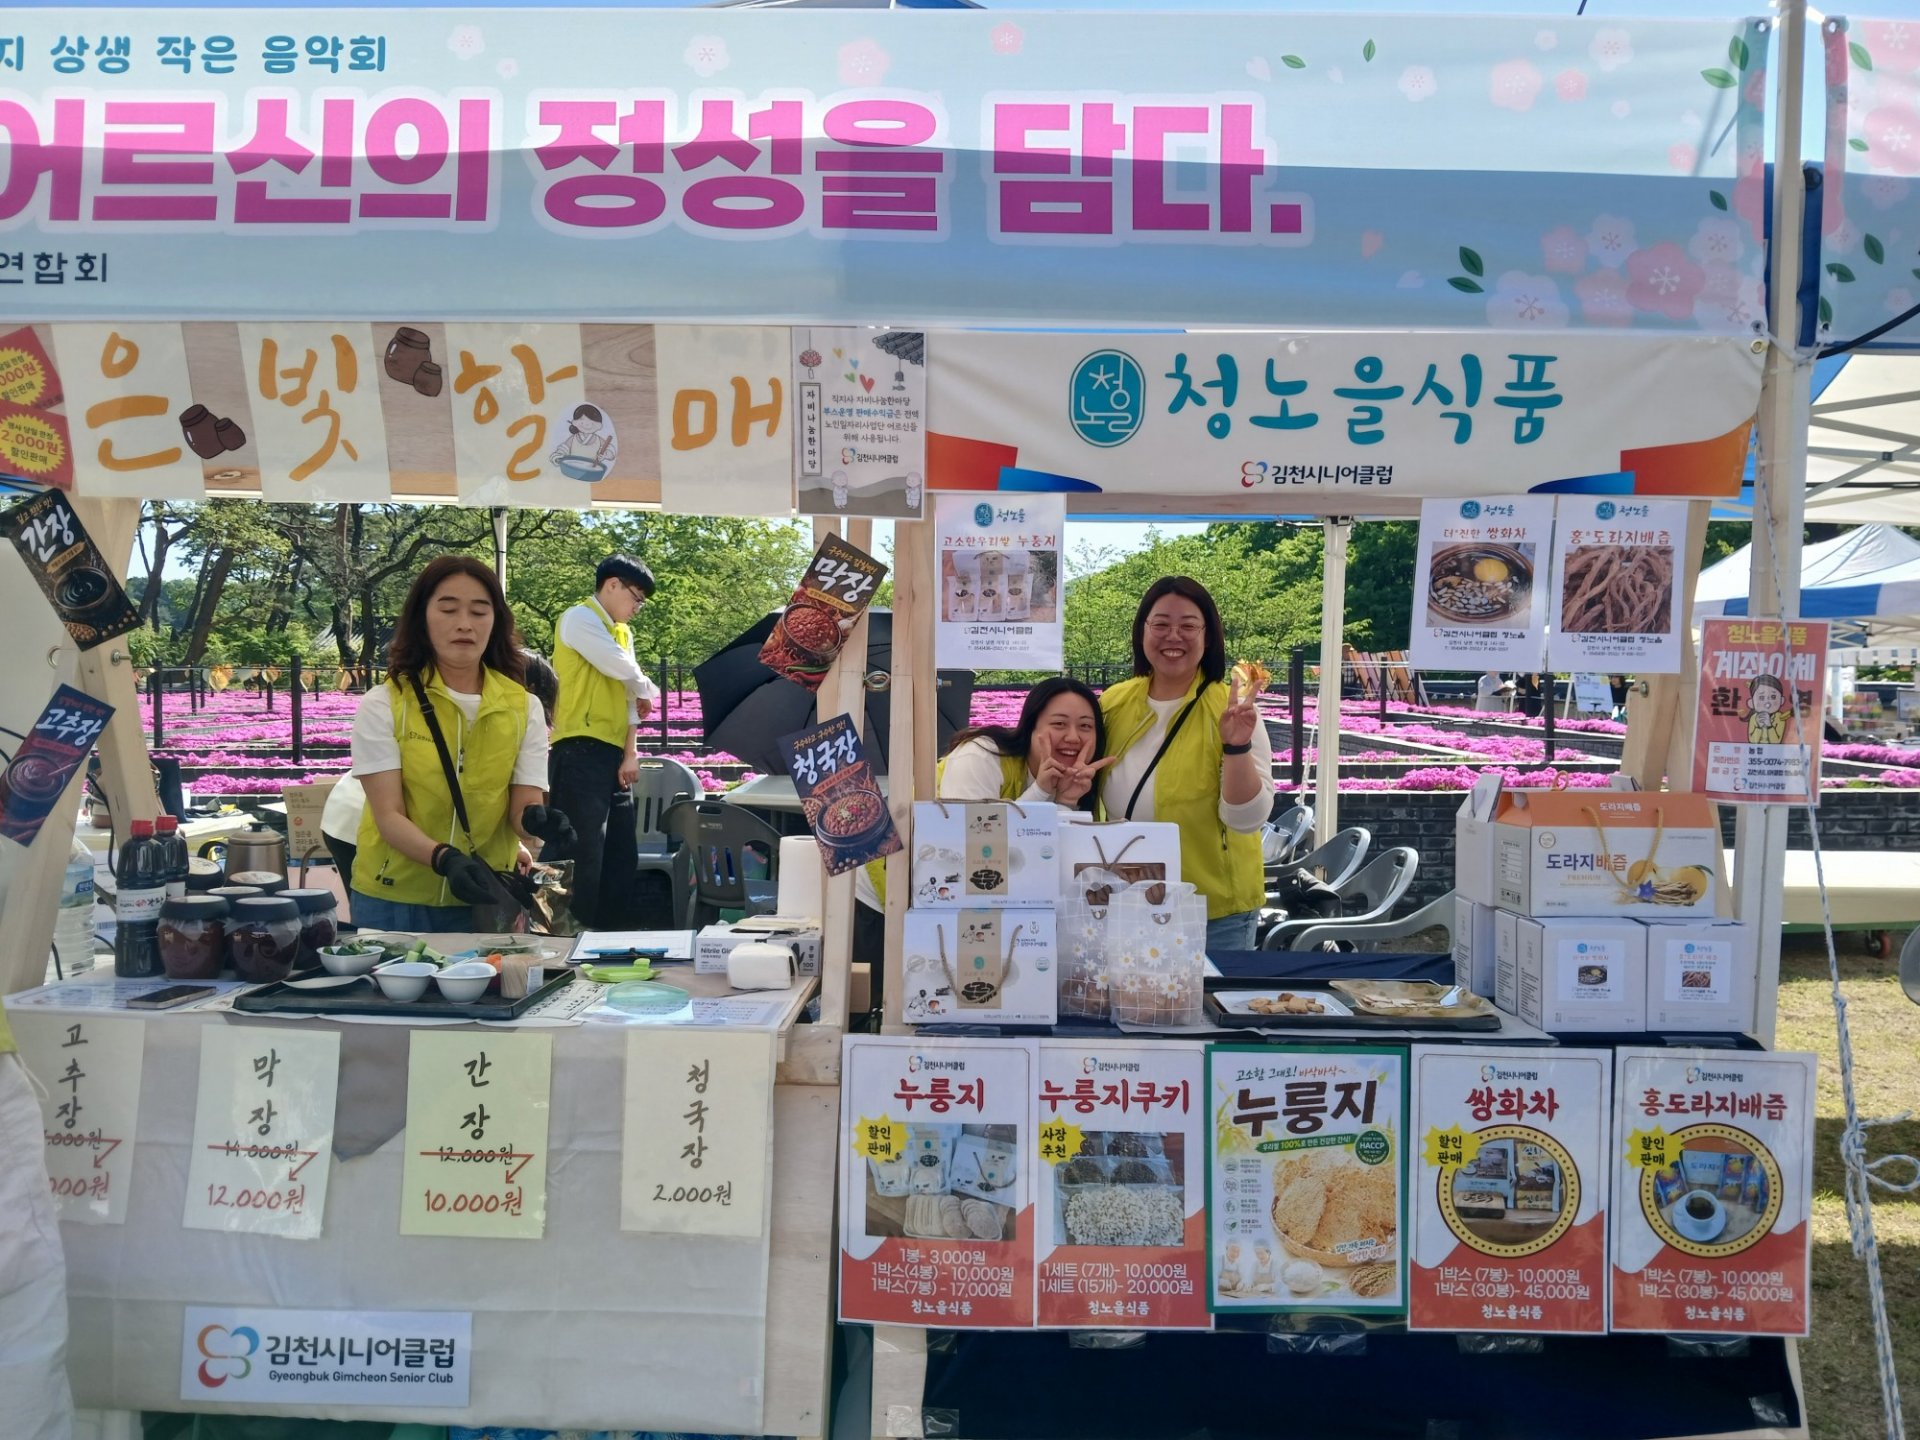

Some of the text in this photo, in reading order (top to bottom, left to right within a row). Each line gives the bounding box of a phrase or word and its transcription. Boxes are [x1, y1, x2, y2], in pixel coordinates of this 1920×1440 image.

[50, 35, 132, 73] 상생
[157, 36, 238, 74] 작은
[261, 35, 387, 73] 음악회
[0, 98, 1302, 234] 어르신의 정성을 담다.
[0, 251, 108, 285] 연합회
[1165, 353, 1563, 446] 청노을식품
[857, 453, 899, 464] 김천시니어클럽
[1271, 463, 1393, 487] 김천시니어클럽
[20, 504, 76, 564] 간장
[1486, 527, 1527, 539] 쌍화차
[814, 556, 874, 603] 막장
[1713, 650, 1816, 682] 계좌이체
[35, 708, 103, 747] 고추장
[792, 729, 858, 786] 청국장
[1546, 853, 1628, 872] 도라지배즙
[923, 1060, 966, 1071] 김천시니어클럽
[1098, 1062, 1140, 1073] 김천시니어클럽
[55, 1023, 88, 1129] 고추장
[1496, 1070, 1538, 1081] 김천시니어클럽
[1701, 1072, 1744, 1083] 김천시니어클럽
[248, 1048, 281, 1136] 막장
[459, 1051, 492, 1140] 간장
[893, 1077, 984, 1114] 누룽지
[1039, 1078, 1190, 1115] 누룽지쿠키
[1232, 1080, 1378, 1138] 누룽지
[1464, 1086, 1560, 1123] 쌍화차
[1639, 1088, 1788, 1121] 홍도라지배즙
[680, 1059, 710, 1169] 청국장
[868, 1124, 892, 1140] 할인
[1041, 1127, 1067, 1142] 사장
[1438, 1133, 1463, 1149] 할인
[867, 1141, 892, 1156] 판매
[1041, 1143, 1067, 1158] 추천
[1359, 1141, 1385, 1151] HACCP
[1641, 1135, 1665, 1150] 할인
[1437, 1151, 1463, 1165] 판매
[1640, 1152, 1666, 1166] 판매
[929, 1249, 987, 1266] 3,000원
[951, 1266, 1015, 1283] 10,000원
[1043, 1262, 1079, 1278] 1세트
[1123, 1263, 1188, 1280] 10,000원
[1438, 1267, 1473, 1282] 1박스
[1517, 1268, 1580, 1284] 10,000원
[1643, 1268, 1676, 1283] 1박스
[1721, 1270, 1784, 1286] 10,000원
[949, 1281, 1013, 1298] 17,000원
[1039, 1278, 1075, 1294] 1세트
[1127, 1279, 1194, 1296] 20,000원
[1435, 1283, 1469, 1297] 1박스
[1524, 1284, 1590, 1301] 45,000원
[1638, 1284, 1673, 1298] 1박스
[1727, 1286, 1793, 1302] 45,000원
[911, 1299, 974, 1316] 청노을식품
[1088, 1300, 1150, 1317] 청노을식품
[1481, 1304, 1543, 1320] 청노을식품
[1685, 1306, 1746, 1322] 청노을식품
[266, 1335, 456, 1369] 김천시니어클럽
[269, 1370, 454, 1384] Gyeongbuk Gimcheon Senior Club
